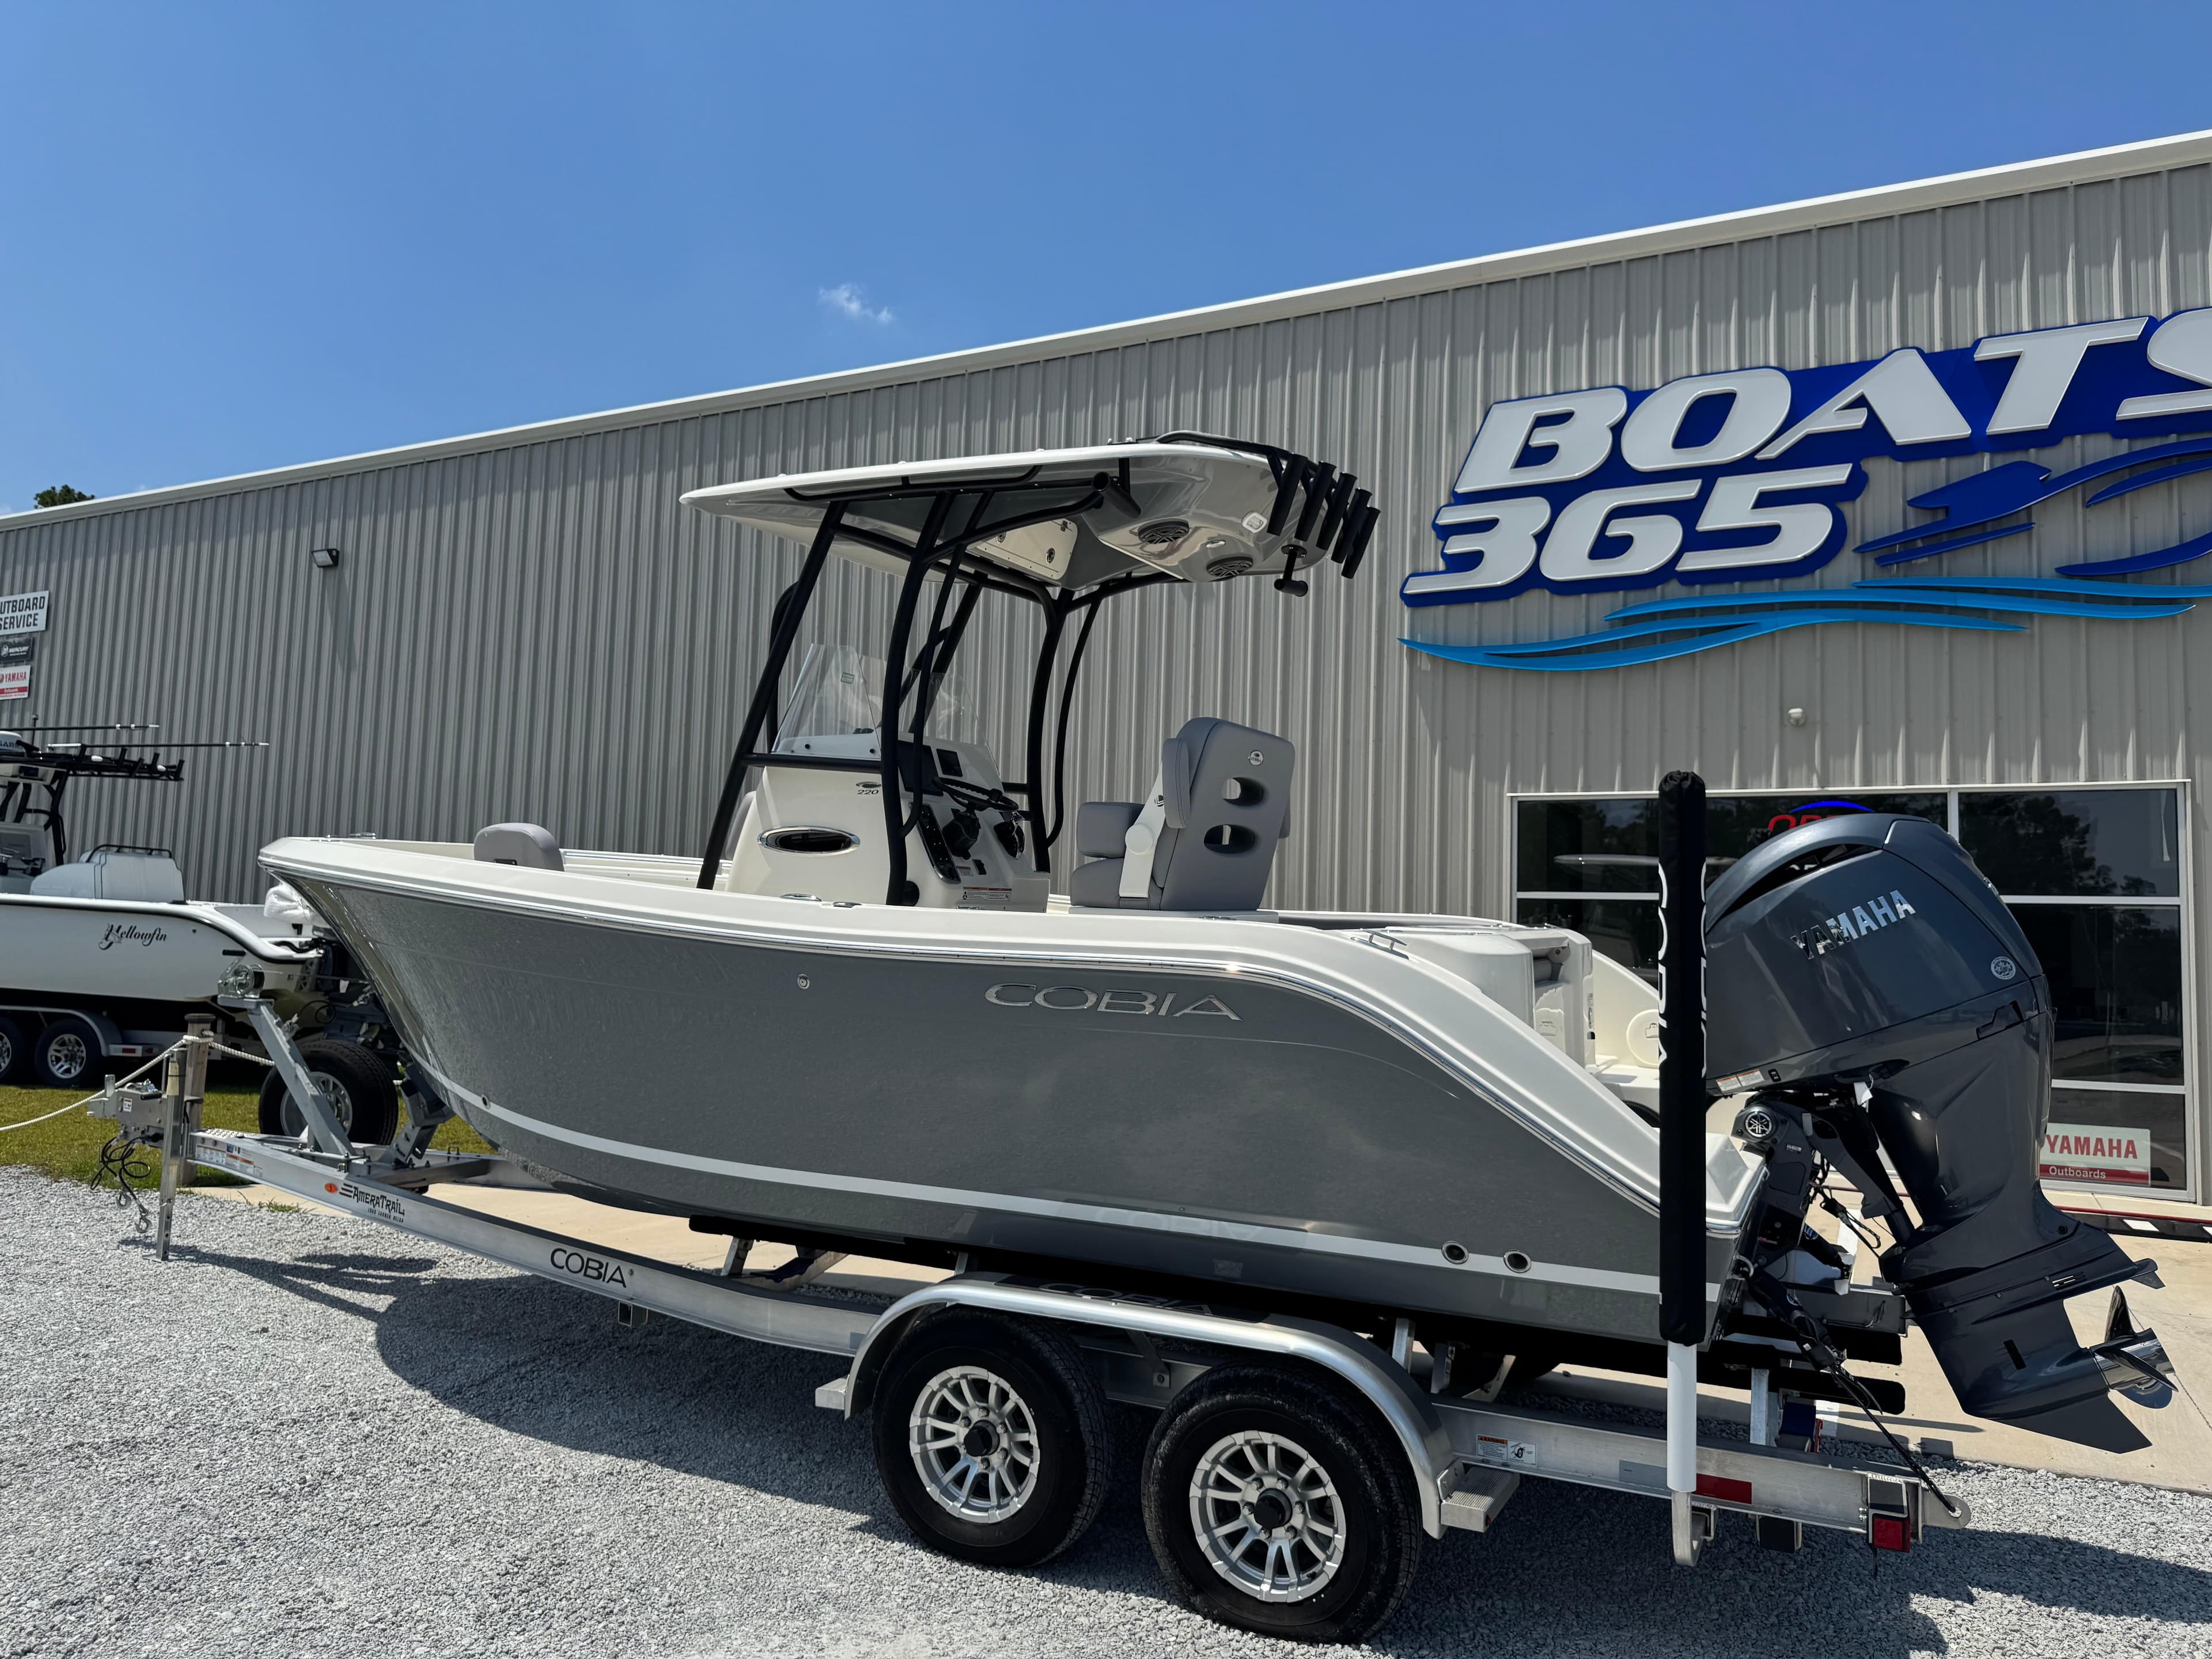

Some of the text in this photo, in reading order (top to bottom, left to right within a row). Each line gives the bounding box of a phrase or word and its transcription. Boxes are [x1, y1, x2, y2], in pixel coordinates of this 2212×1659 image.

[1403, 463, 1853, 593] 365
[0, 596, 46, 615] UTBOARD
[5, 671, 27, 683] YAMAHA
[98, 922, 167, 951] Yellowfin
[1790, 889, 1916, 960] YAMAHA
[984, 982, 1244, 1022] COBIA
[2046, 1134, 2138, 1160] YAMAHA
[2049, 1165, 2106, 1179] Outboards
[550, 1248, 627, 1288] COBIA
